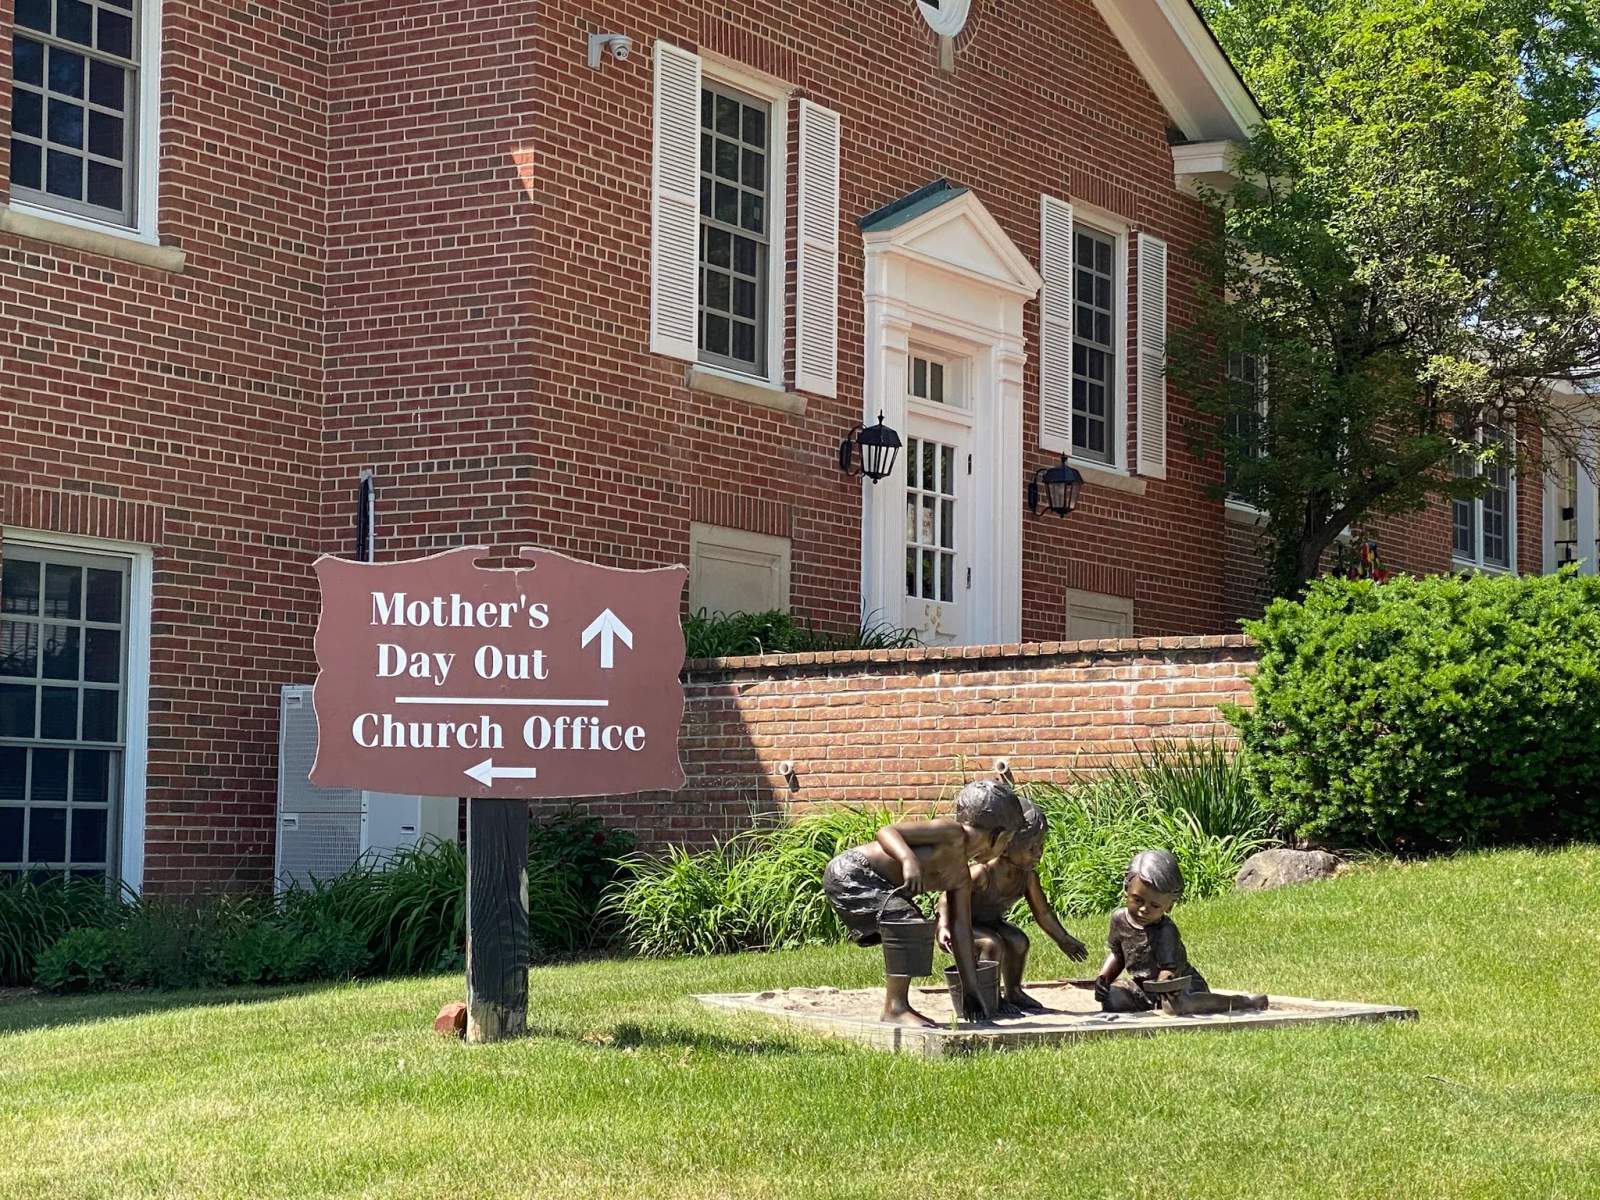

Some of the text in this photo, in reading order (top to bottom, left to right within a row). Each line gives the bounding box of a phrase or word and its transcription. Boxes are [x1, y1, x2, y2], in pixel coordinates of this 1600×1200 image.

[370, 592, 549, 628] Mother's
[376, 644, 549, 685] Day Out
[353, 713, 646, 751] Church Office
